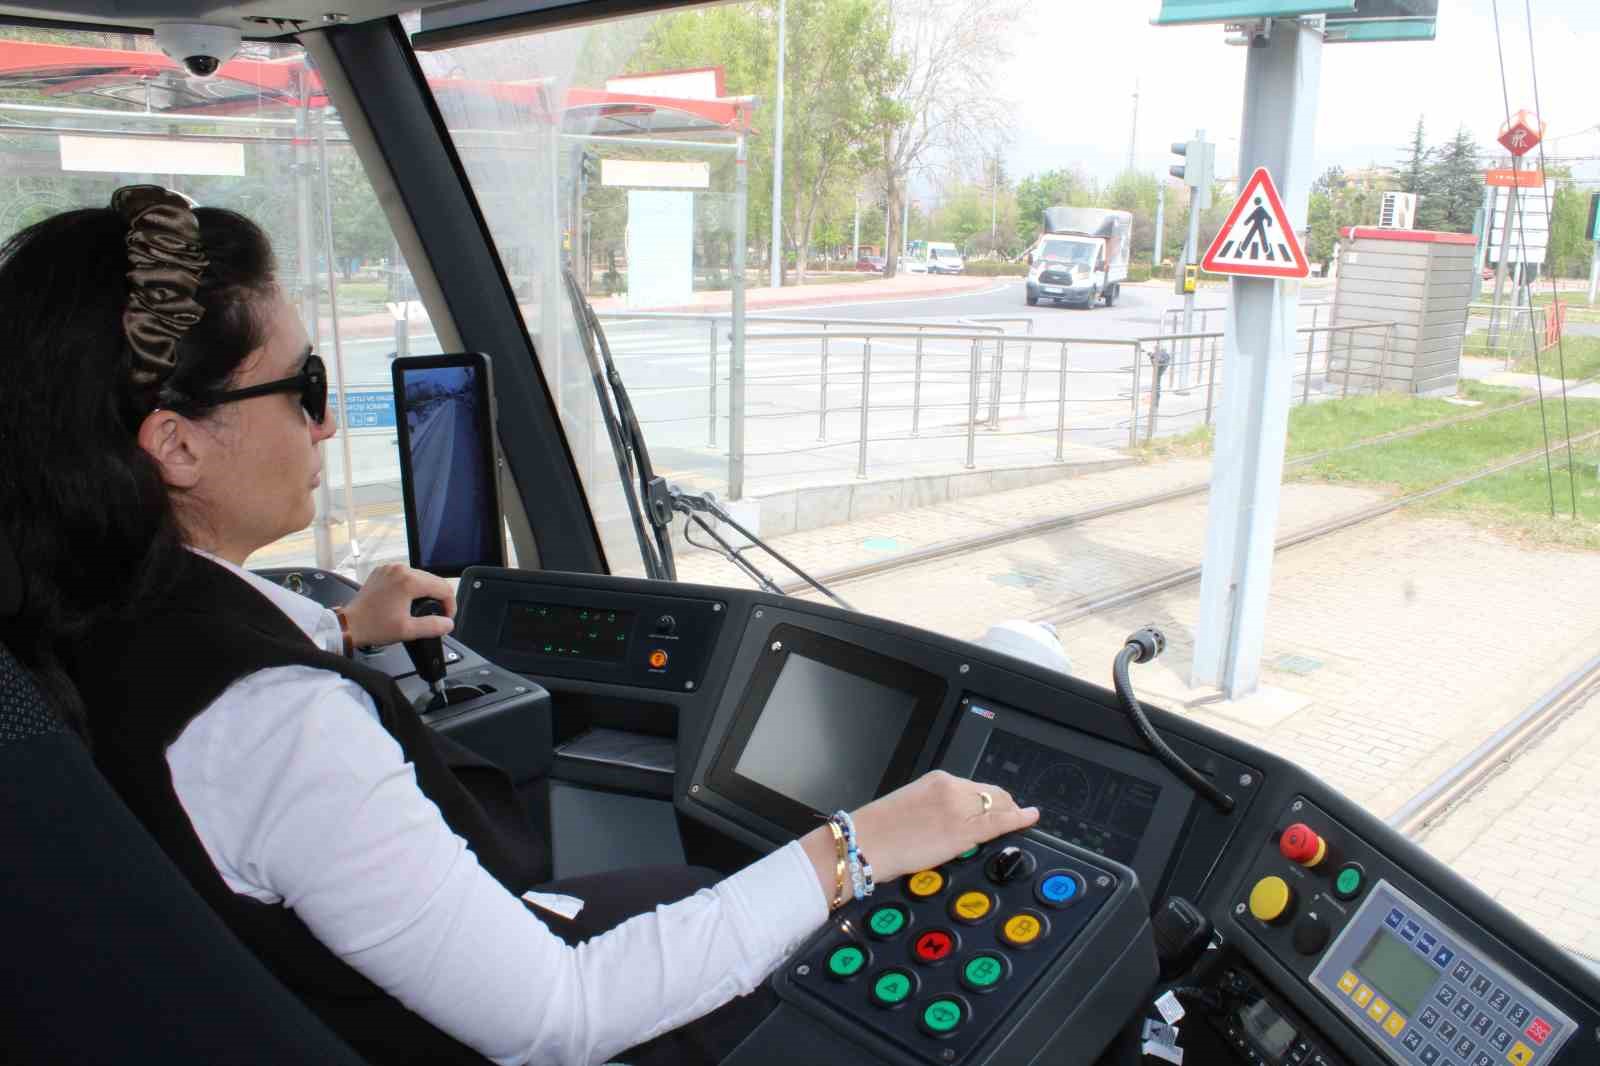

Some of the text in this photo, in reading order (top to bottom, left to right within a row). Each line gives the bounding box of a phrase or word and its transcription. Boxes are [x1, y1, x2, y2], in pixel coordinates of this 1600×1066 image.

[1456, 966, 1469, 979] F1
[1477, 978, 1485, 989] 1
[1440, 988, 1453, 1001] F2
[1494, 992, 1505, 1004] 2
[1461, 1002, 1470, 1013] 4
[1514, 1007, 1525, 1019] 3
[1421, 1011, 1435, 1024] F3
[1478, 1016, 1488, 1027] 5
[1442, 1024, 1452, 1035] 7
[1406, 1034, 1419, 1047] F4
[1497, 1032, 1507, 1043] 6
[1460, 1041, 1469, 1052] 8
[1479, 1056, 1489, 1066] 9
